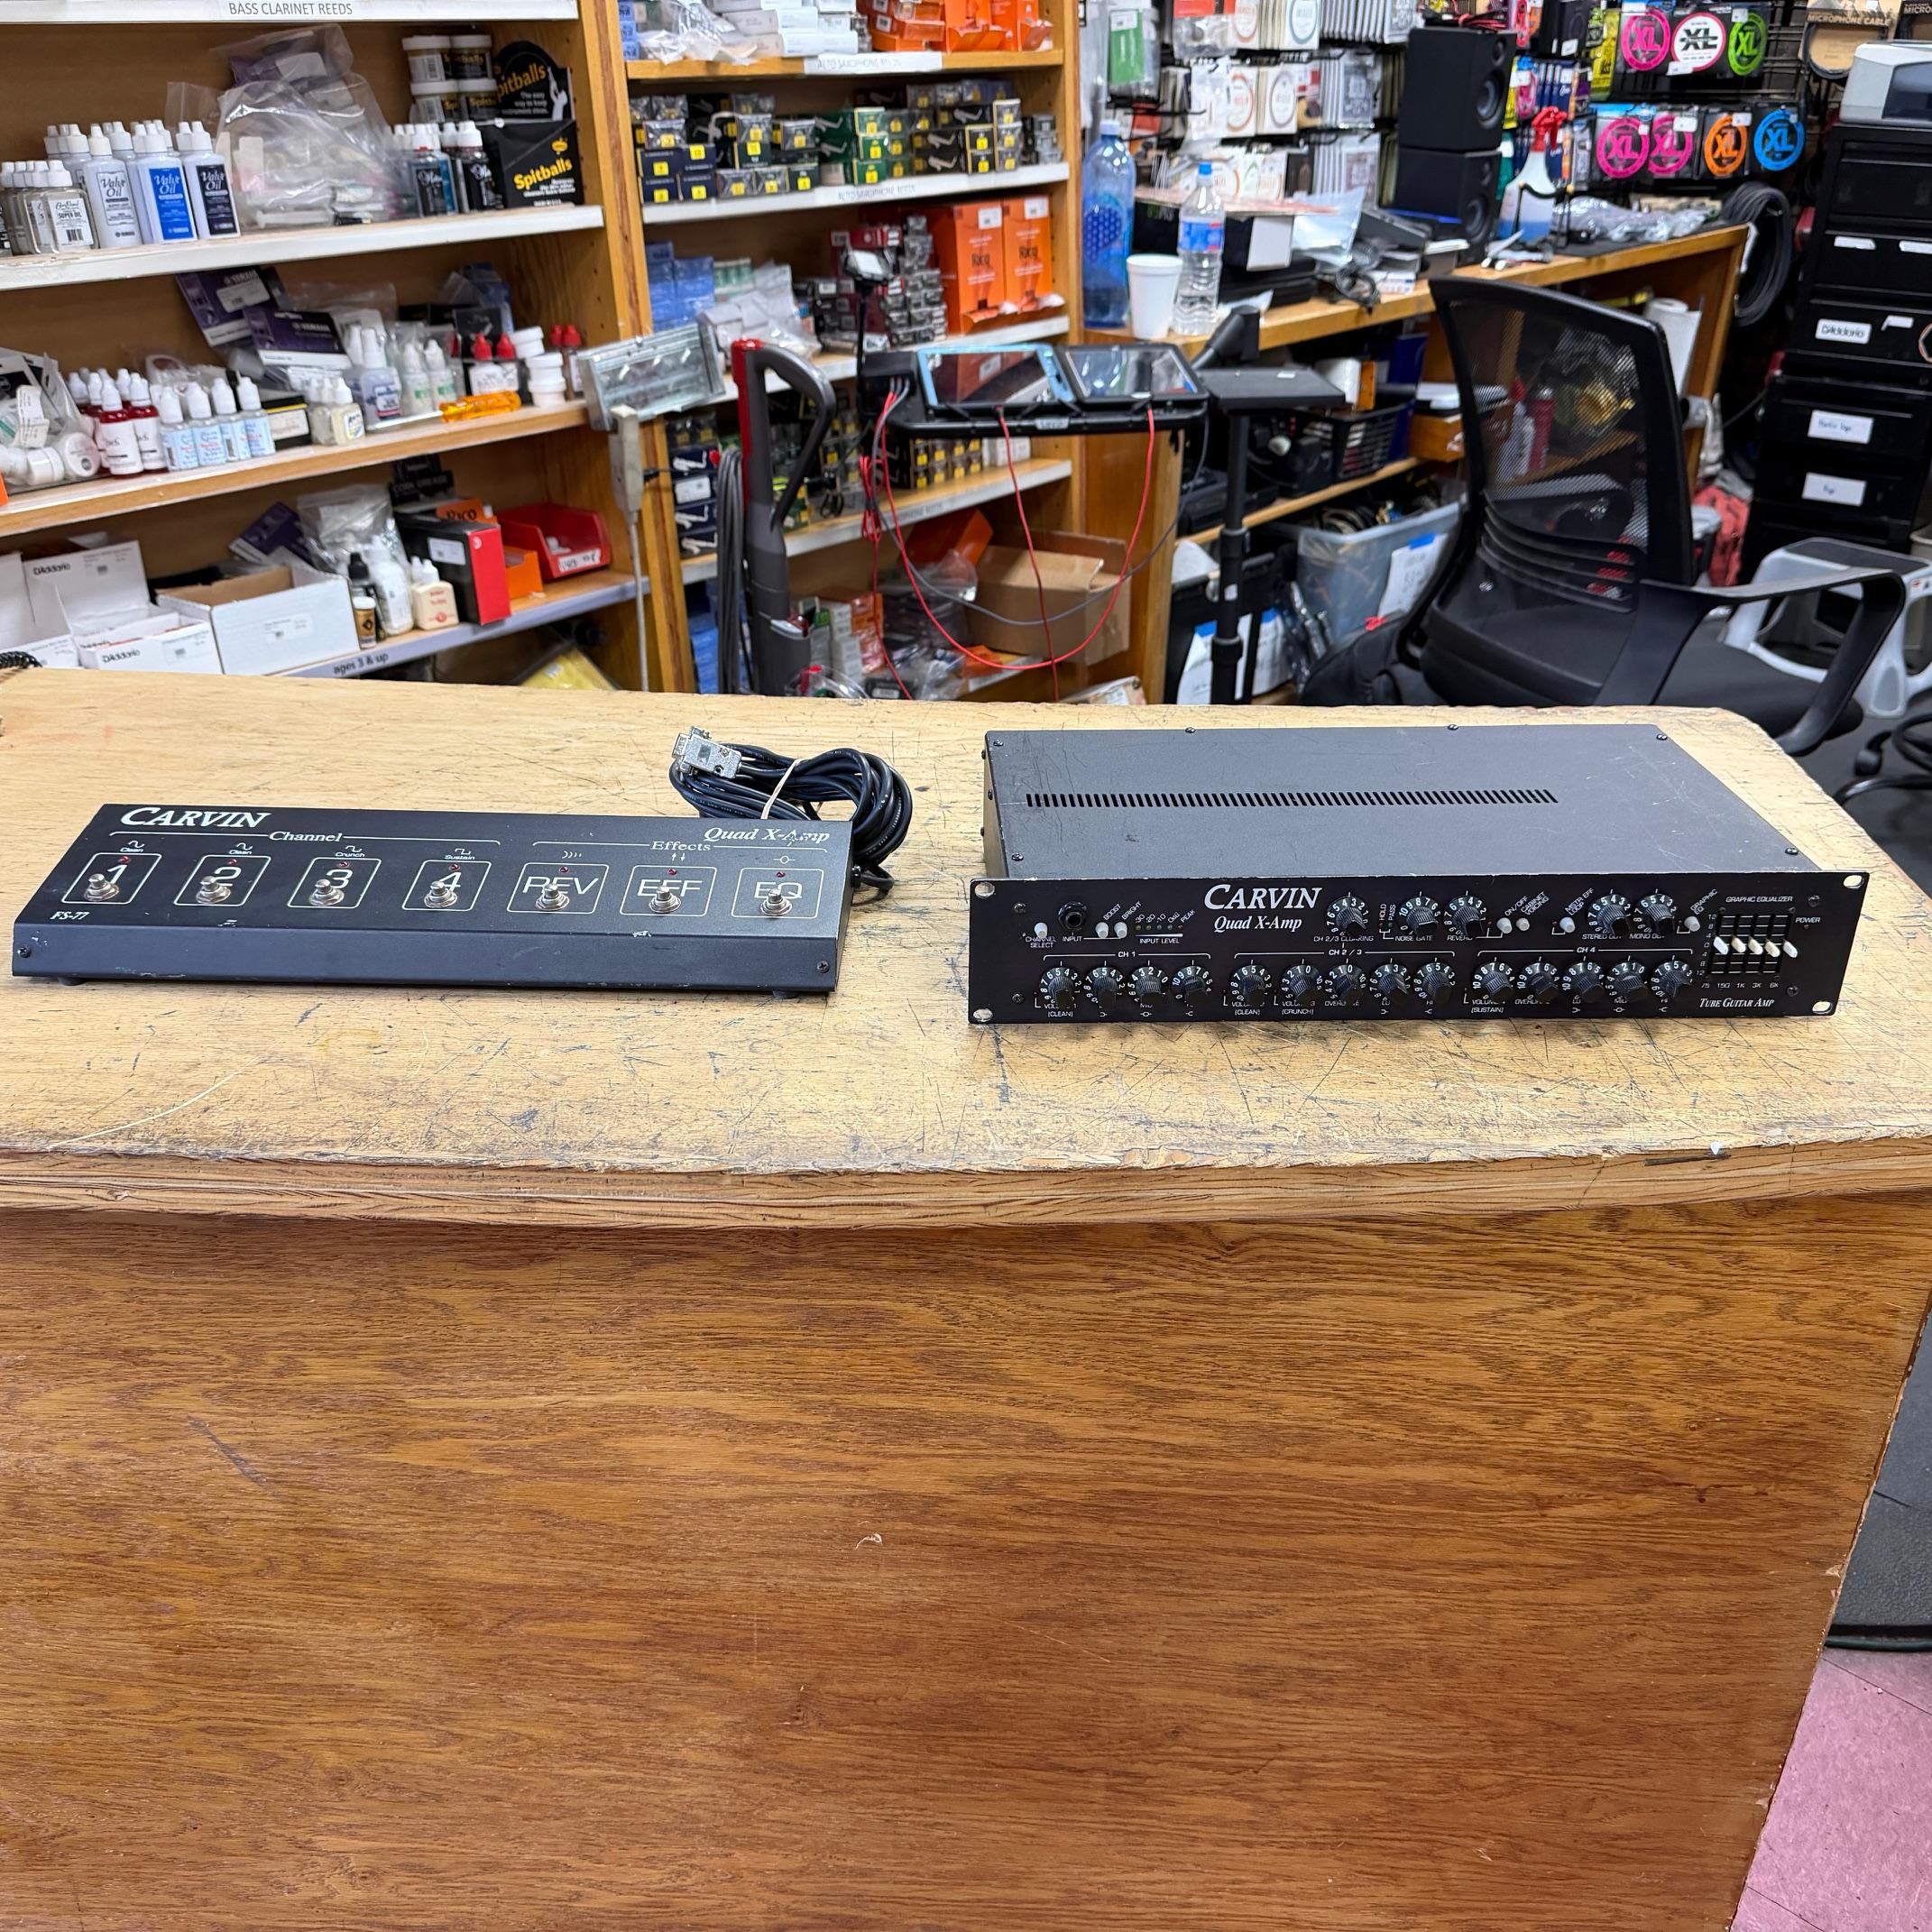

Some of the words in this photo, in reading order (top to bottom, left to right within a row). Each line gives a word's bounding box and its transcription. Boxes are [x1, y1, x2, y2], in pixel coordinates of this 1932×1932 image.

[229, 3, 259, 14] BASS
[262, 3, 315, 14] CLARINET
[318, 3, 353, 14] REEDS
[1808, 14, 1862, 24] MICROPHONE
[1863, 17, 1891, 26] CABLE
[1631, 26, 1661, 51] XL
[1679, 28, 1718, 51] XL
[1737, 32, 1758, 56] XL
[497, 63, 547, 99] pitballs
[1607, 135, 1639, 159] XL
[1651, 132, 1683, 157] XL
[1714, 130, 1738, 158] XL
[1765, 129, 1795, 152] XL
[513, 157, 573, 190] Spitballs
[106, 187, 123, 198] Oil
[160, 183, 176, 195] Oil
[207, 179, 222, 190] Oil
[333, 661, 356, 676] ages
[375, 653, 389, 665] up
[120, 807, 271, 828] CARVIN
[268, 831, 343, 842] Channel
[703, 827, 759, 842] Quad
[651, 841, 711, 851] Effects
[107, 864, 128, 885] 1
[214, 866, 242, 887] 2
[326, 869, 354, 889] 3
[522, 876, 599, 895] REV
[637, 879, 704, 897] EFF
[754, 881, 803, 899] EQ
[1204, 884, 1323, 910] CARVIN
[1504, 896, 1529, 916] ON/OFF
[1520, 891, 1546, 913] CABINET
[1525, 896, 1550, 915] VOICING
[1564, 895, 1584, 913] MSTR
[1582, 888, 1595, 899] EFF
[1690, 888, 1718, 911] GRAPHIC
[50, 911, 90, 920] FS-77
[1103, 904, 1122, 921] BOOST
[1121, 901, 1143, 921] BRIGHT
[1180, 909, 1196, 924] PEAK
[1569, 901, 1585, 915] LOOP
[1214, 915, 1253, 933] Quad
[1255, 916, 1302, 933] X-Amp
[1699, 998, 1721, 1007] TUBE
[1722, 998, 1753, 1007] GUITAR
[1753, 998, 1775, 1007] AMP
